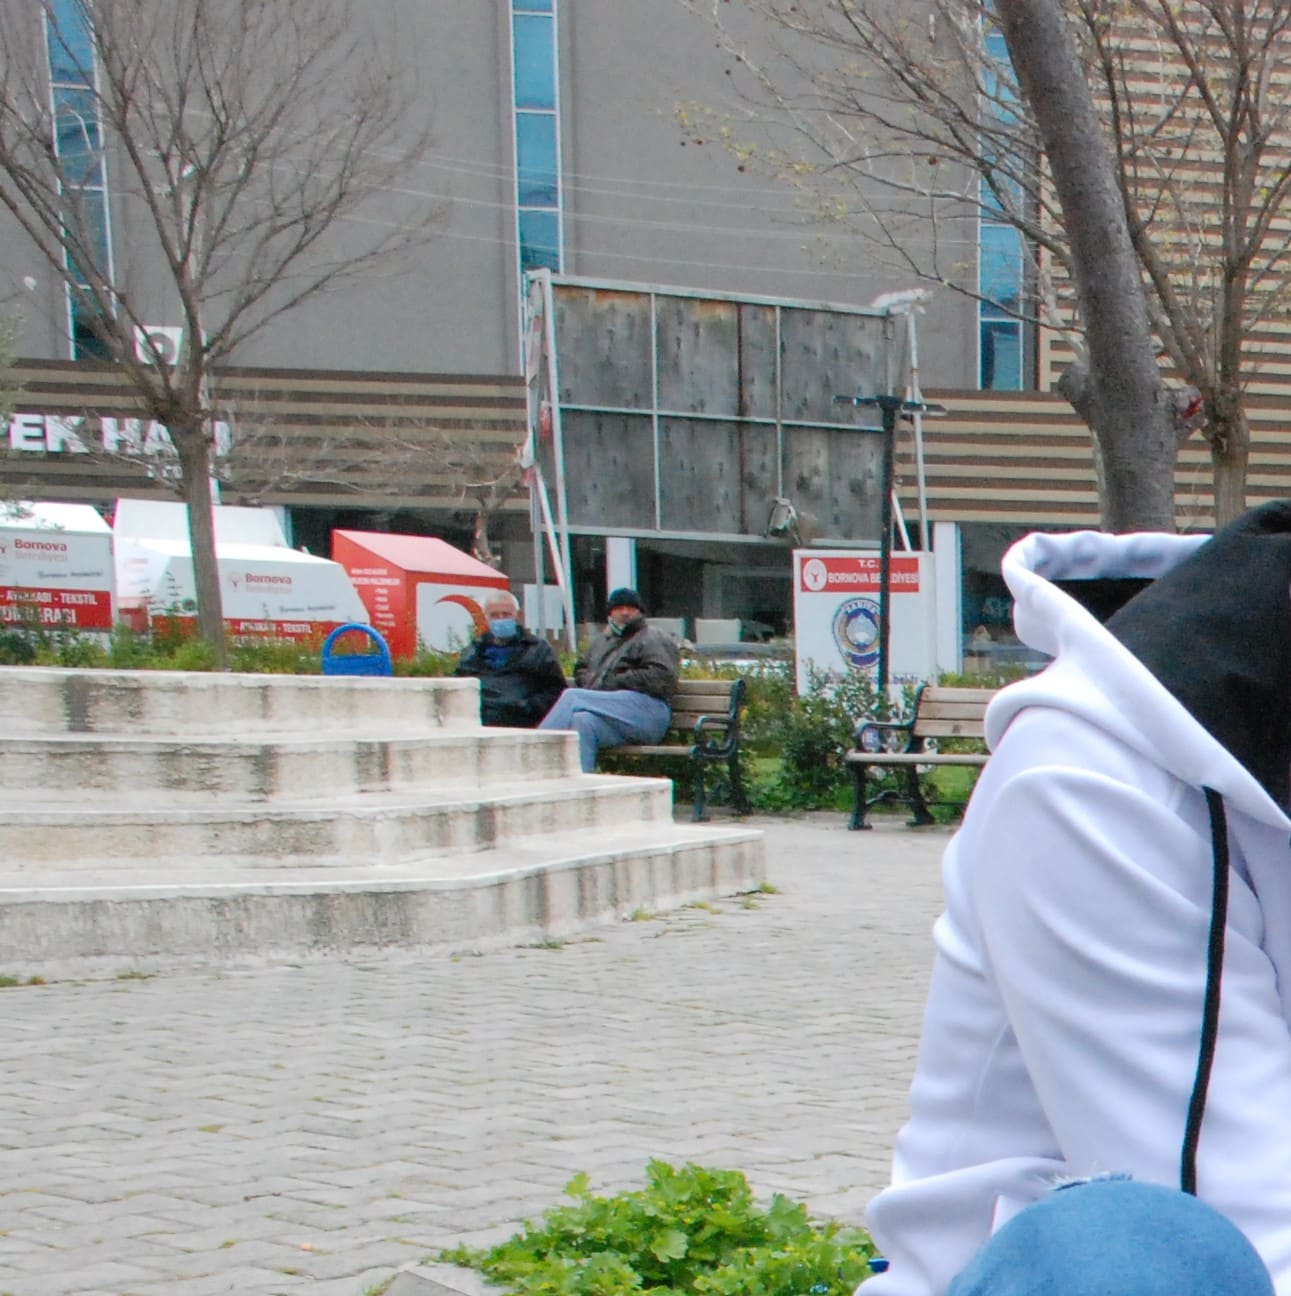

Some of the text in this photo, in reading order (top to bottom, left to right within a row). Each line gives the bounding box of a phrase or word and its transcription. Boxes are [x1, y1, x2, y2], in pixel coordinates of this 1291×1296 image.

[0, 414, 232, 456] EK HAI
[14, 538, 68, 552] Bornova
[245, 573, 292, 585] Bornova
